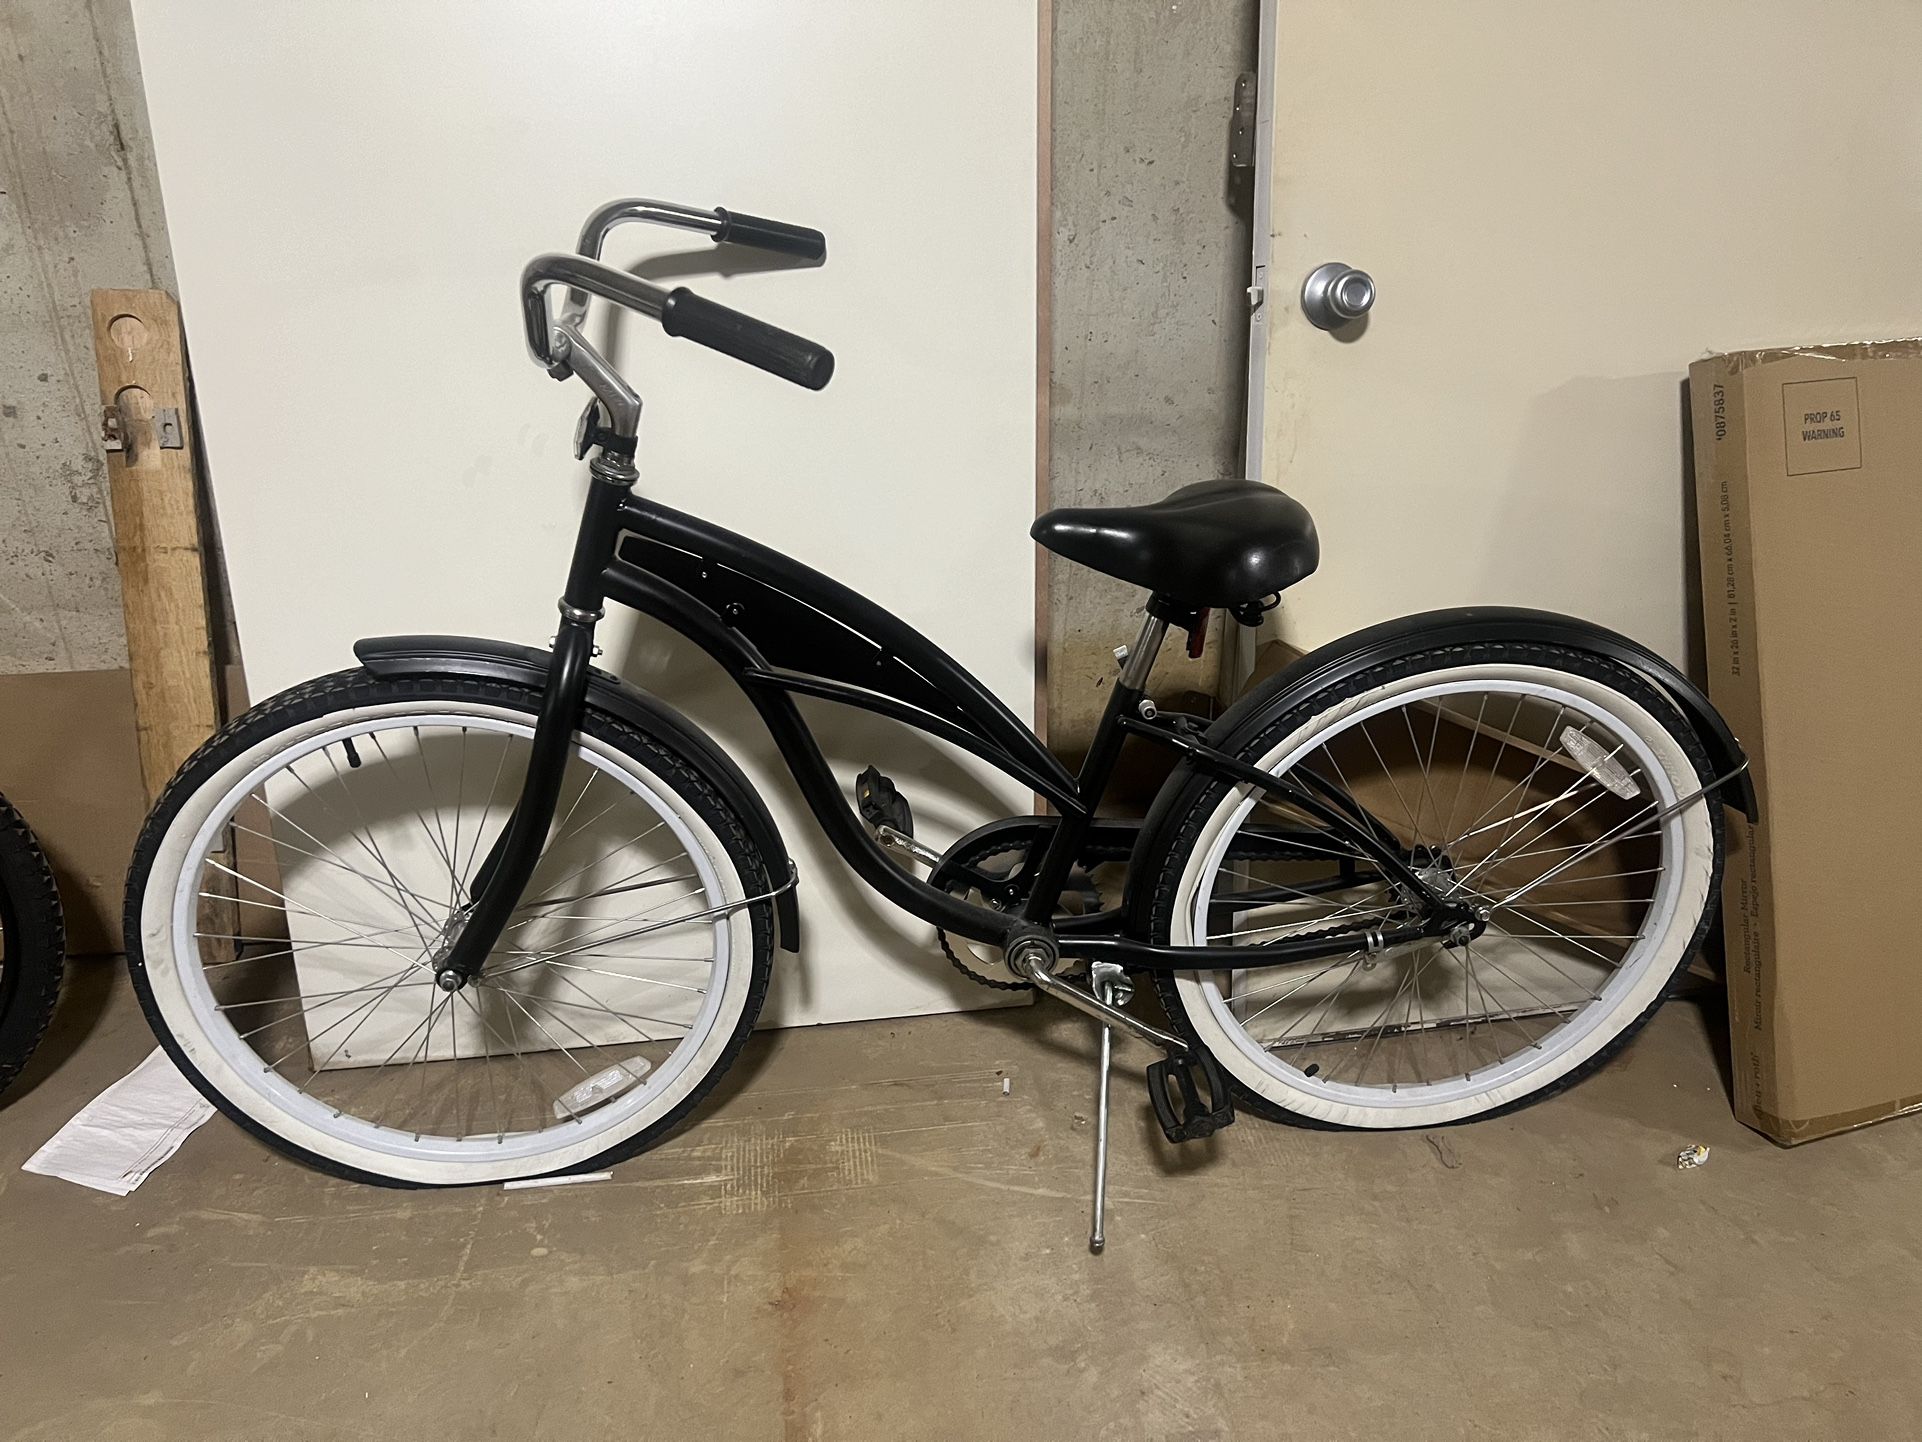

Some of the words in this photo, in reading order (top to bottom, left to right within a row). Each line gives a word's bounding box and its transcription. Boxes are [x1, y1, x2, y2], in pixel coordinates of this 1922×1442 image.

[1804, 411, 1828, 424] PROP
[1830, 410, 1841, 422] 65
[1802, 426, 1845, 442] WARNING
[1721, 480, 1728, 493] cm
[1724, 519, 1731, 532] cm
[1727, 563, 1735, 576] cm
[1740, 878, 1749, 911] Mirror
[1740, 913, 1751, 974] Rectangular
